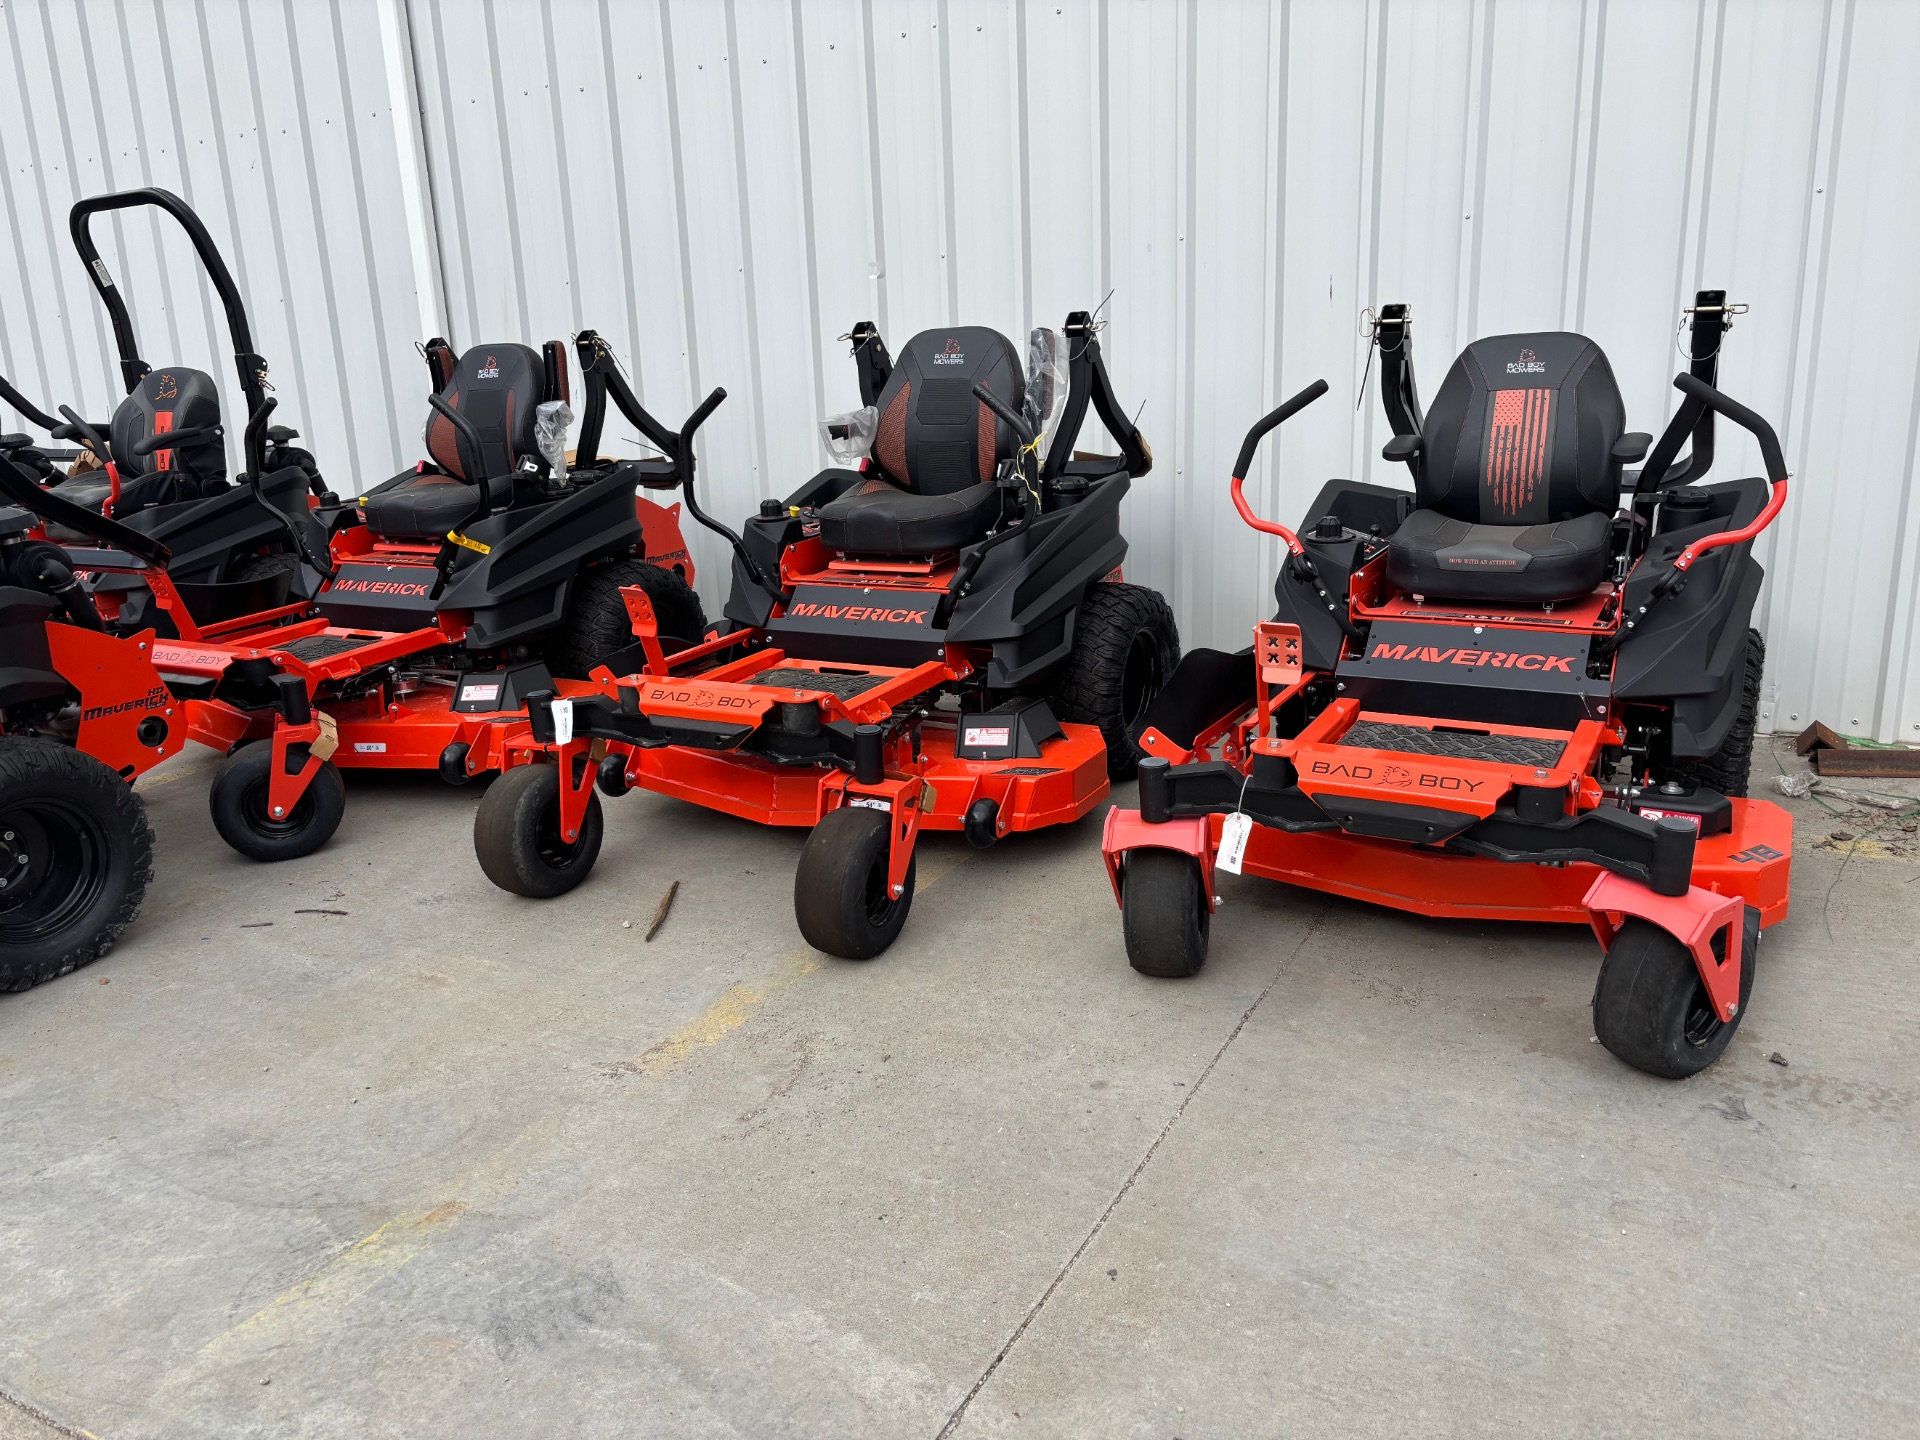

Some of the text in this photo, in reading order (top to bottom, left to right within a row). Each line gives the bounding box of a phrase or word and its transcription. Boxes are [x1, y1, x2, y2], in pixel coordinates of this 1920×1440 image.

[333, 579, 430, 596] MAVERICK
[791, 603, 929, 624] MAVERICK
[152, 651, 227, 666] BAD BOY
[1371, 643, 1578, 673] MAVERICK
[147, 686, 165, 697] HD
[650, 689, 761, 709] BAD BOY
[83, 692, 169, 721] MAVERICK
[1311, 761, 1485, 793] BAD BOY
[1726, 844, 1785, 863] 48
